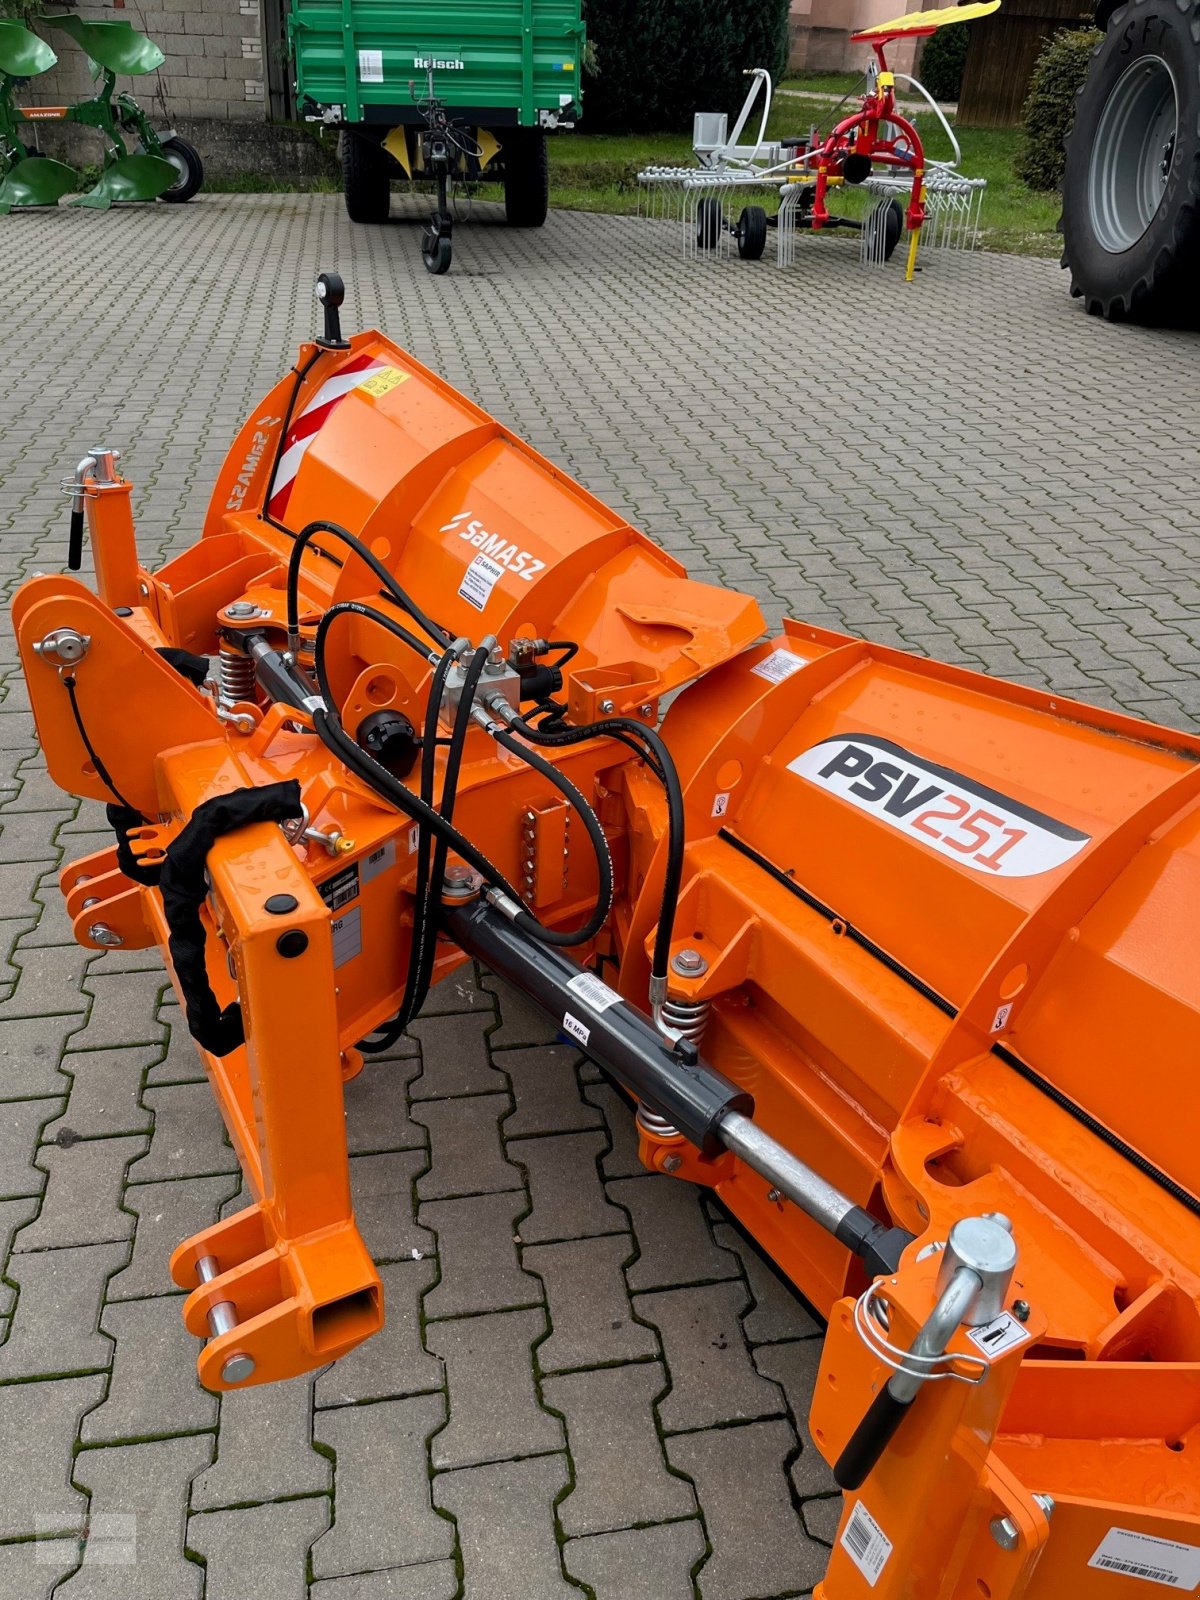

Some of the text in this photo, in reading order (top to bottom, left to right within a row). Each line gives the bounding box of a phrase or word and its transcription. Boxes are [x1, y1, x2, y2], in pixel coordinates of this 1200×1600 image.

[1120, 14, 1174, 55] SFT
[414, 58, 464, 70] Reisch
[459, 520, 547, 581] SaMASZ
[480, 561, 501, 578] SAPHIR
[817, 744, 1028, 872] PSV251
[565, 1019, 587, 1040] 16 MPa
